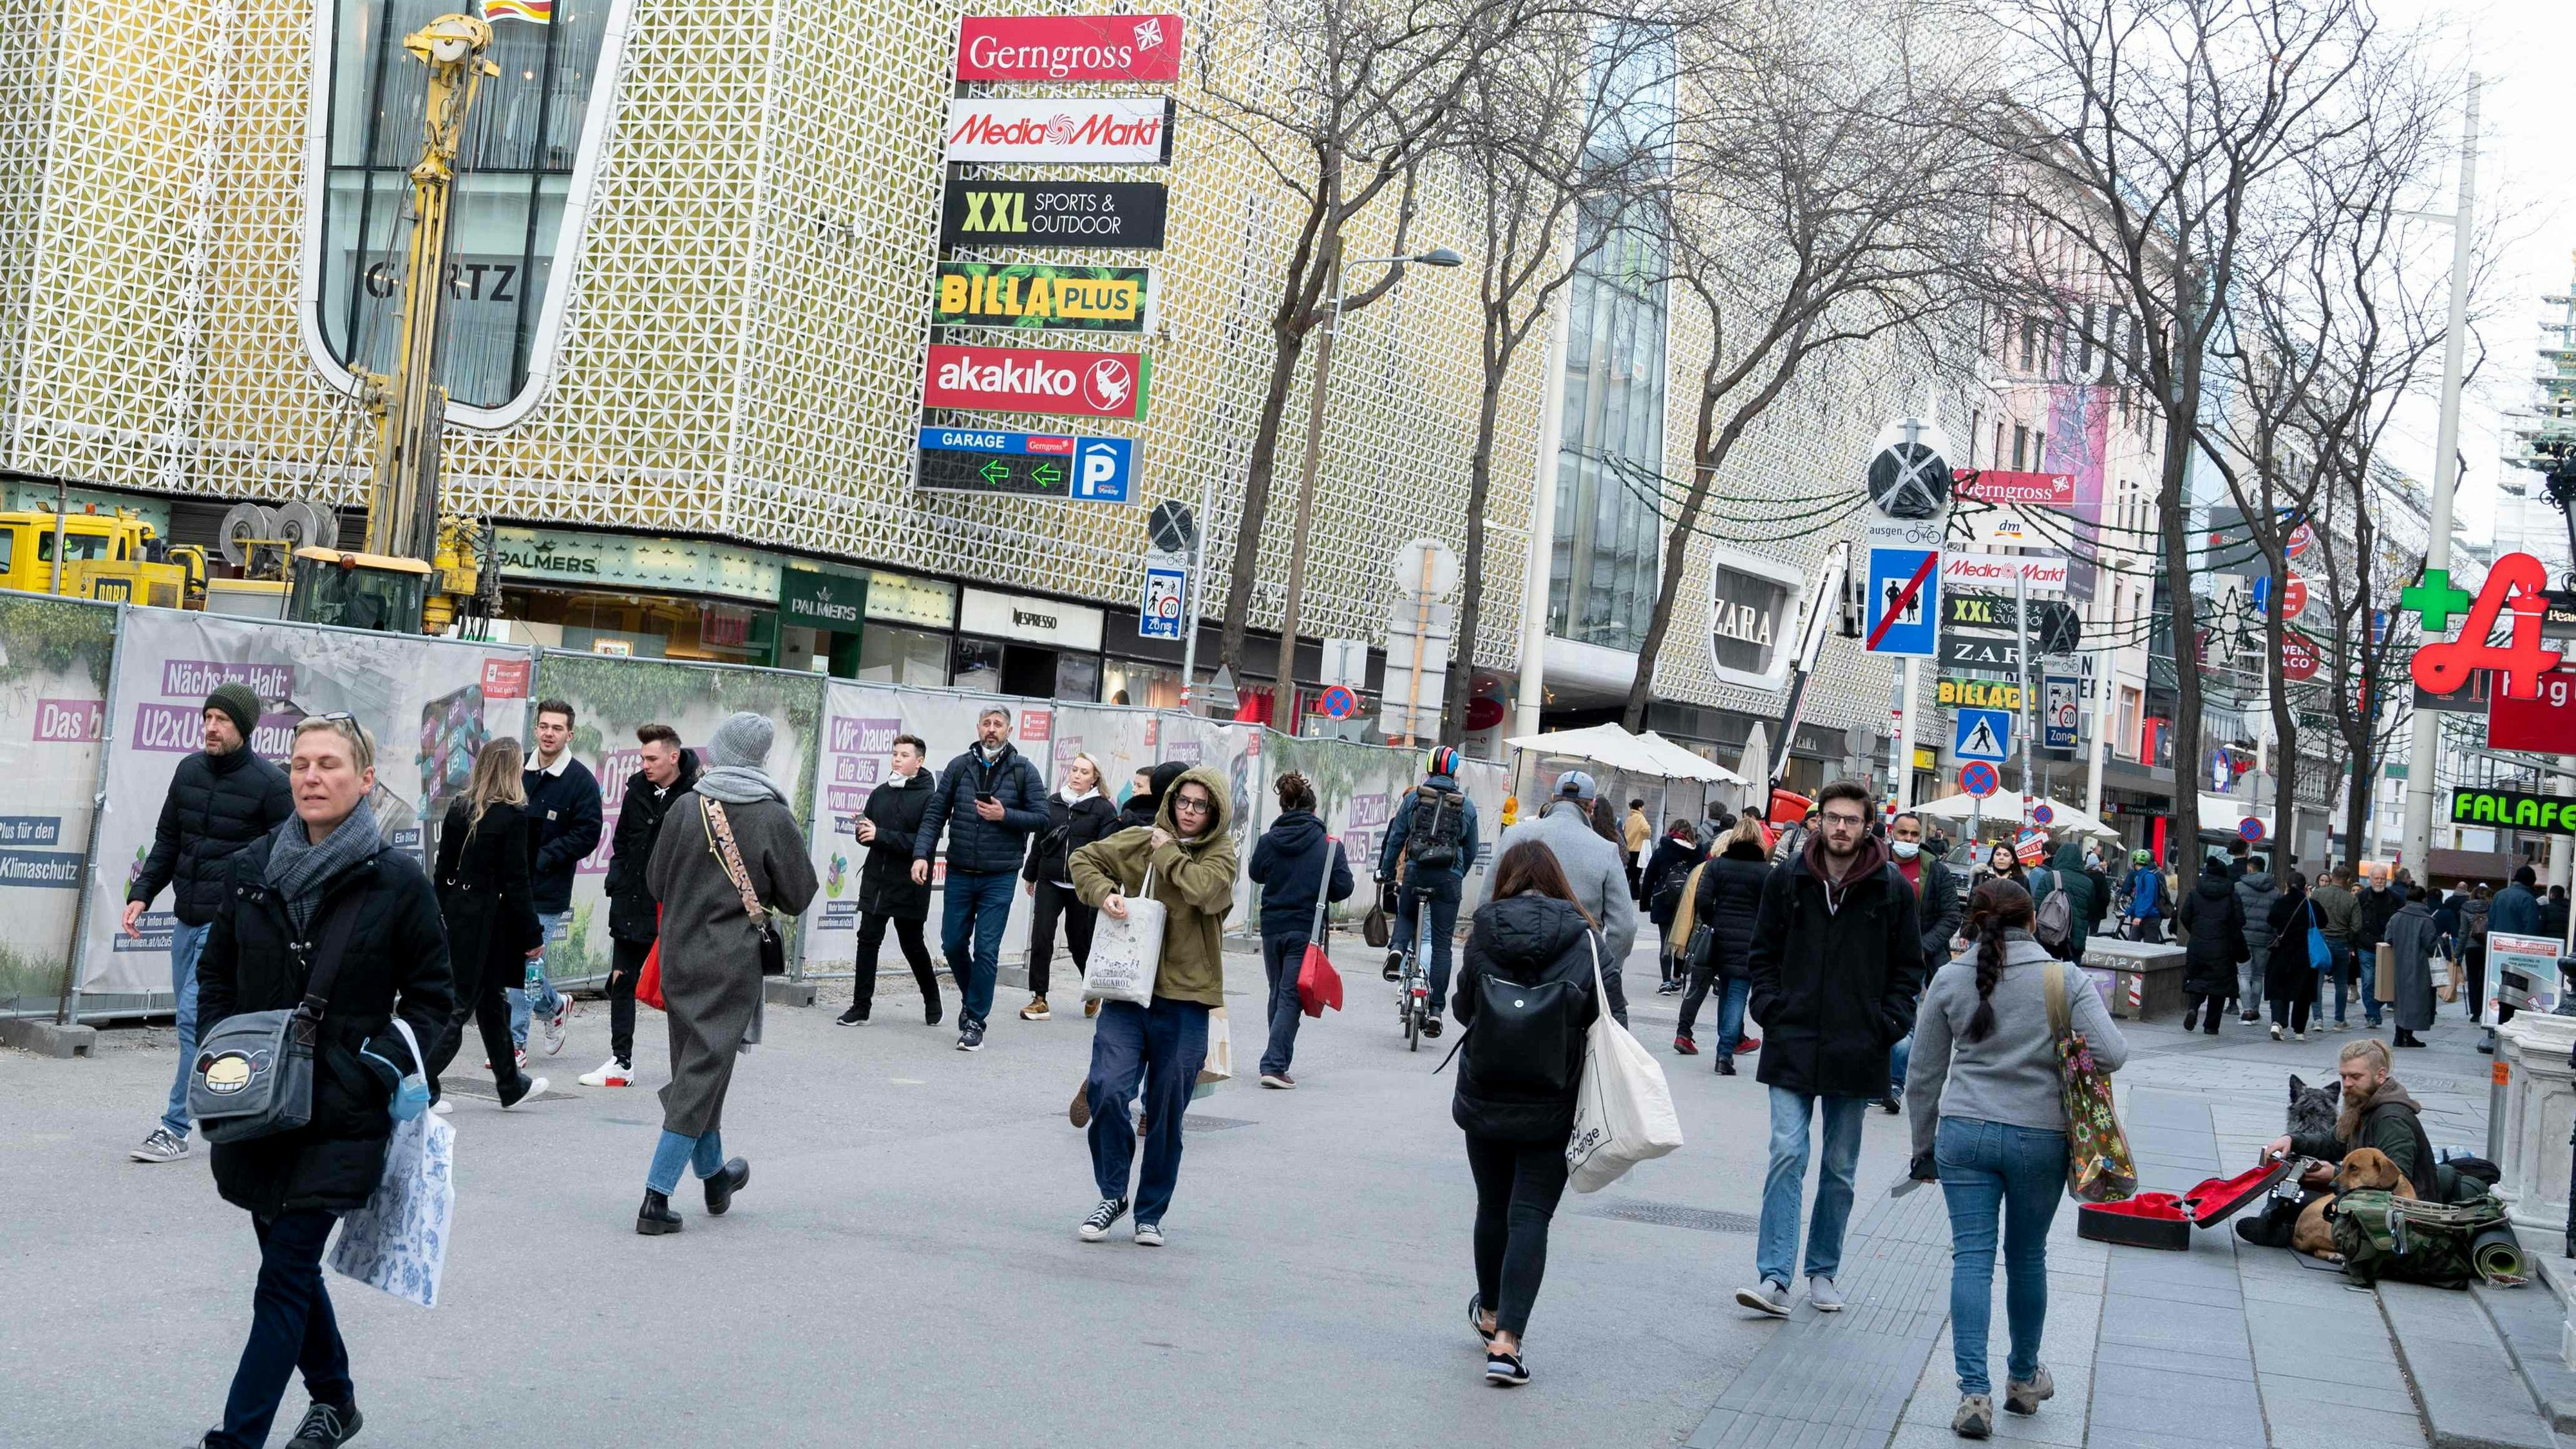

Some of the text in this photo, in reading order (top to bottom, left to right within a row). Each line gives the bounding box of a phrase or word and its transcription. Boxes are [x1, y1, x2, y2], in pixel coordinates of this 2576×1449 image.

[969, 35, 1132, 78] Gerngross
[950, 113, 1160, 146] Media Markt
[961, 192, 1028, 232] XXL
[1034, 193, 1115, 212] SPORTS &
[1032, 215, 1121, 234] OUTDOOR
[366, 261, 516, 302] GRTZ
[940, 274, 1130, 317] BILLA PLUS
[938, 355, 1077, 396] akakiko
[942, 432, 1063, 451] GARAGE Gerngross
[1958, 480, 2052, 502] Gerngross
[1870, 526, 1905, 536] ausgen.
[2000, 520, 2020, 531] dm
[498, 551, 596, 574] PALMERS
[1945, 560, 2002, 578] Media
[2020, 564, 2066, 582] Markt
[791, 598, 857, 622] PALMERS
[1012, 607, 1057, 630] NESPRESSO
[1164, 603, 1177, 615] 20
[1954, 600, 1993, 623] XXL
[1148, 619, 1172, 630] Zon
[1714, 598, 1772, 647] ZARA
[1954, 643, 2043, 666] ZARA
[2290, 658, 2309, 668] CO
[249, 668, 288, 697] Halt:
[1939, 682, 2003, 708] BILLA
[41, 704, 82, 739] Das
[2064, 712, 2075, 724] 20
[836, 720, 897, 753] Wir bauen
[1796, 736, 1817, 751] ZARA
[2050, 730, 2072, 741] Zone
[447, 755, 460, 774] U5
[838, 759, 854, 781] die
[430, 777, 441, 796] U2
[829, 791, 845, 808] von
[17, 822, 32, 839] für
[35, 822, 55, 839] den
[395, 833, 405, 843] Ein
[0, 857, 78, 880] Klimaschutz
[135, 916, 146, 927] ehr
[147, 915, 162, 927] Infos
[1566, 1128, 1600, 1162] change
